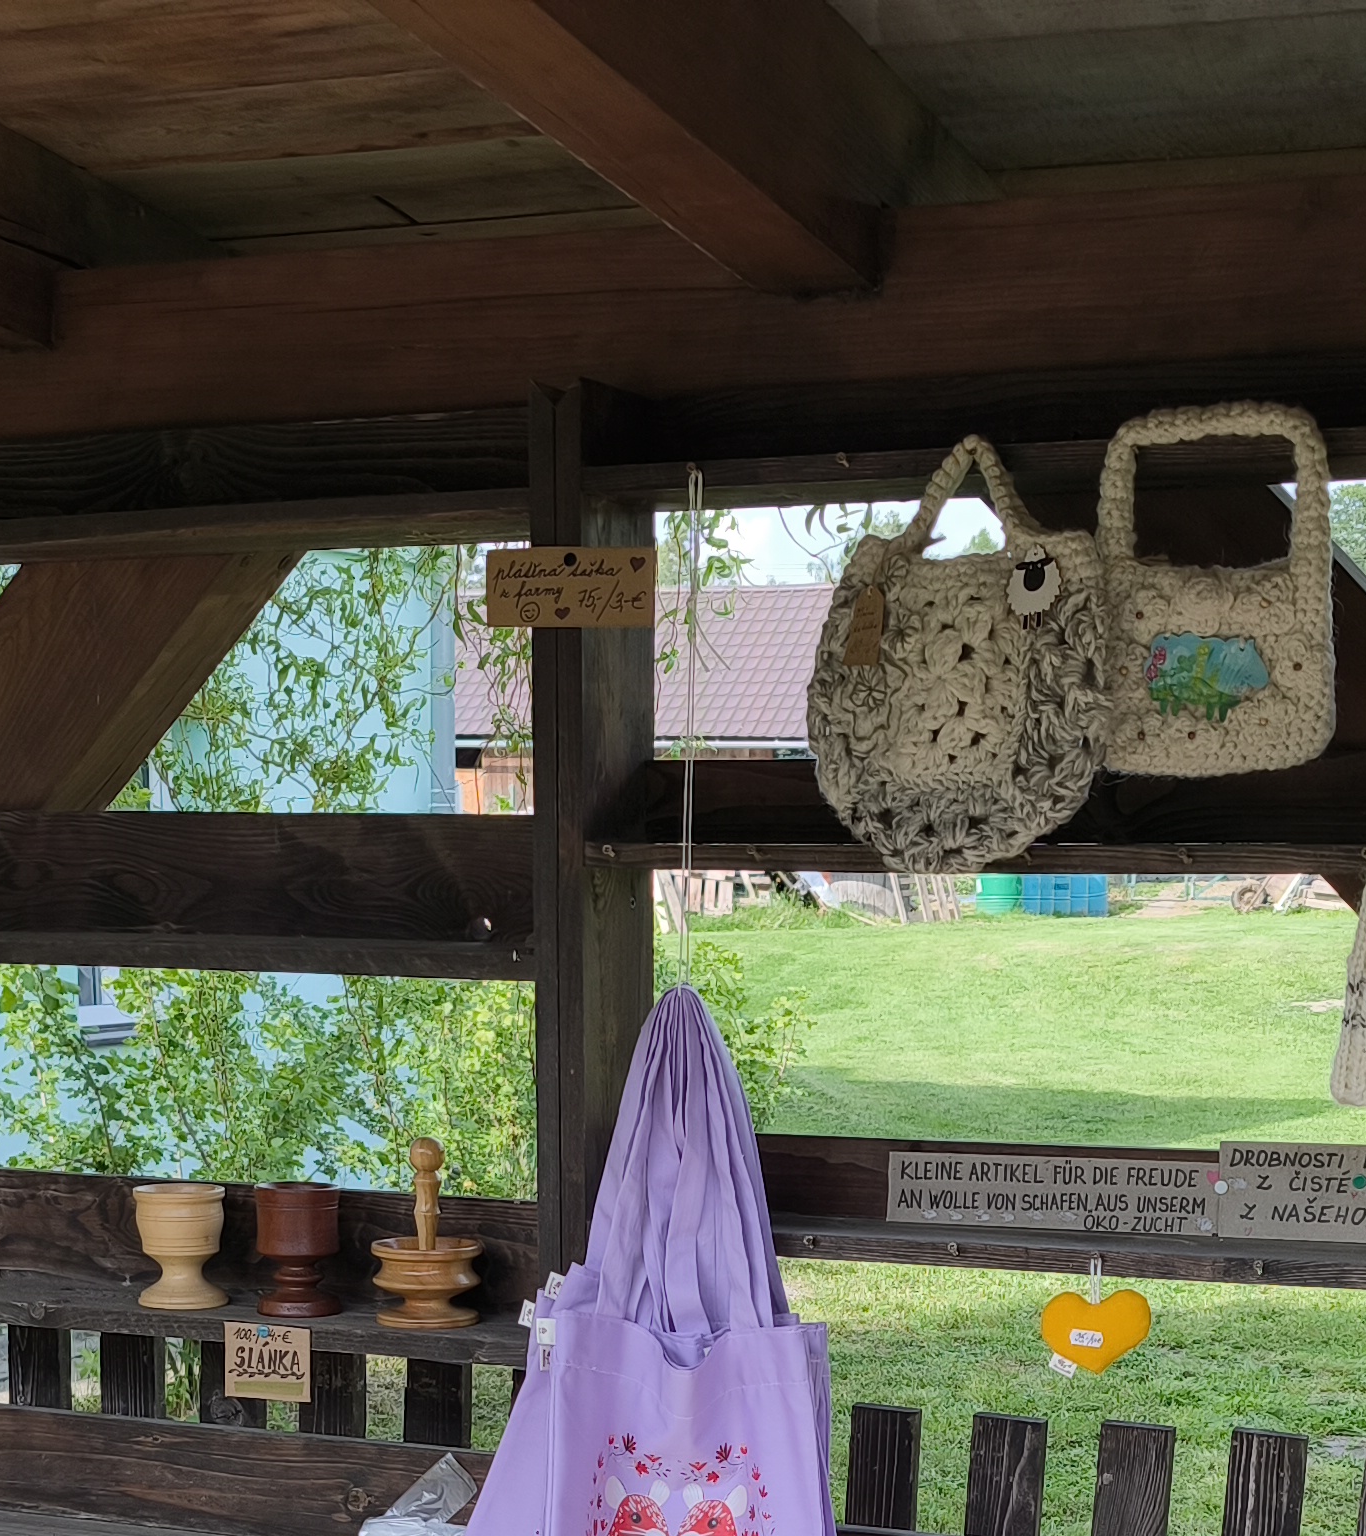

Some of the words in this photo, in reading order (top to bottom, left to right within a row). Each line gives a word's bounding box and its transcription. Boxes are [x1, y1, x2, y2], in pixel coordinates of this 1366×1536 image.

[514, 581, 564, 609] farmy
[1229, 1149, 1344, 1169] DROBNOSTI
[900, 1160, 963, 1181] KLEINE
[969, 1162, 1044, 1184] ARTIKEL
[1053, 1161, 1085, 1185] FÜR
[1093, 1166, 1119, 1186] DIE
[1126, 1167, 1199, 1188] FREUDE
[1256, 1175, 1273, 1191] Z
[1289, 1170, 1352, 1193] ČISTÉ
[897, 1189, 922, 1209] AN
[929, 1189, 980, 1210] WOLLE
[987, 1192, 1016, 1211] VON
[1095, 1193, 1129, 1212] AUS
[1137, 1195, 1205, 1215] UNSERM
[1239, 1203, 1257, 1221] Z
[1271, 1197, 1366, 1225] NAŠEHO
[234, 1341, 300, 1372] SLÁNKA
